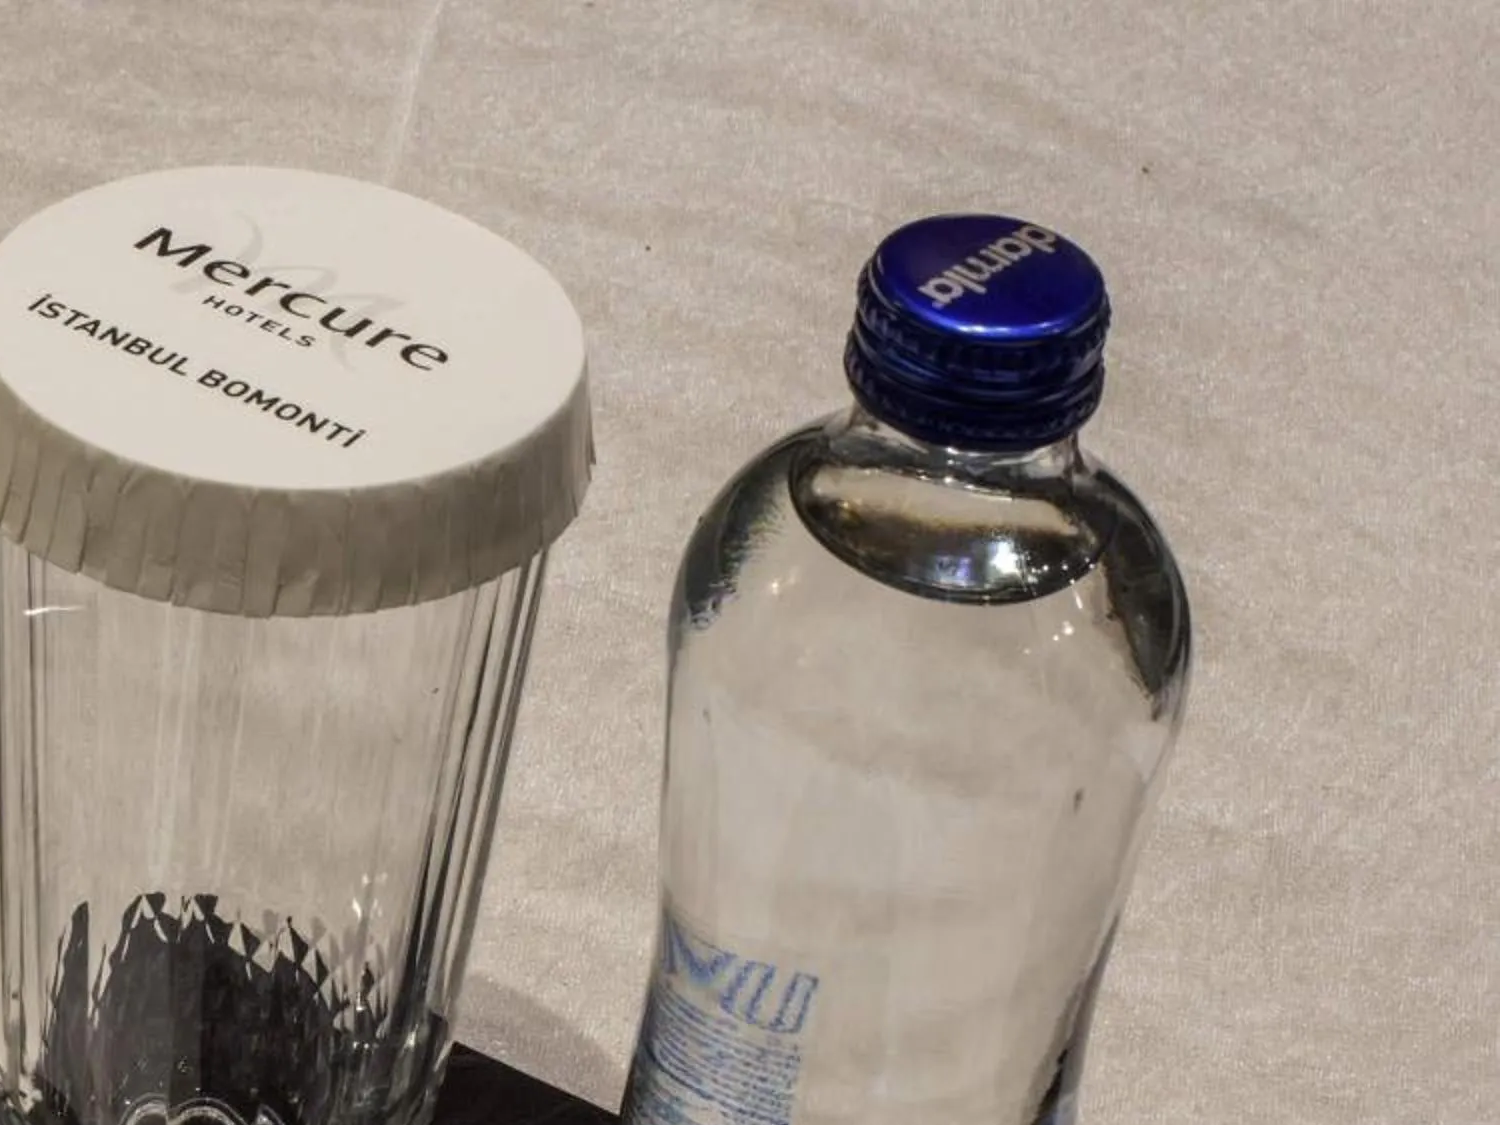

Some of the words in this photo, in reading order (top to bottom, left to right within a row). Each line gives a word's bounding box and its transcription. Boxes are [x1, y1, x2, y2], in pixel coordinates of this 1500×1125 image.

[27, 293, 190, 377] İSTANBUL
[133, 226, 450, 373] Mercure
[201, 294, 316, 349] HOTELS
